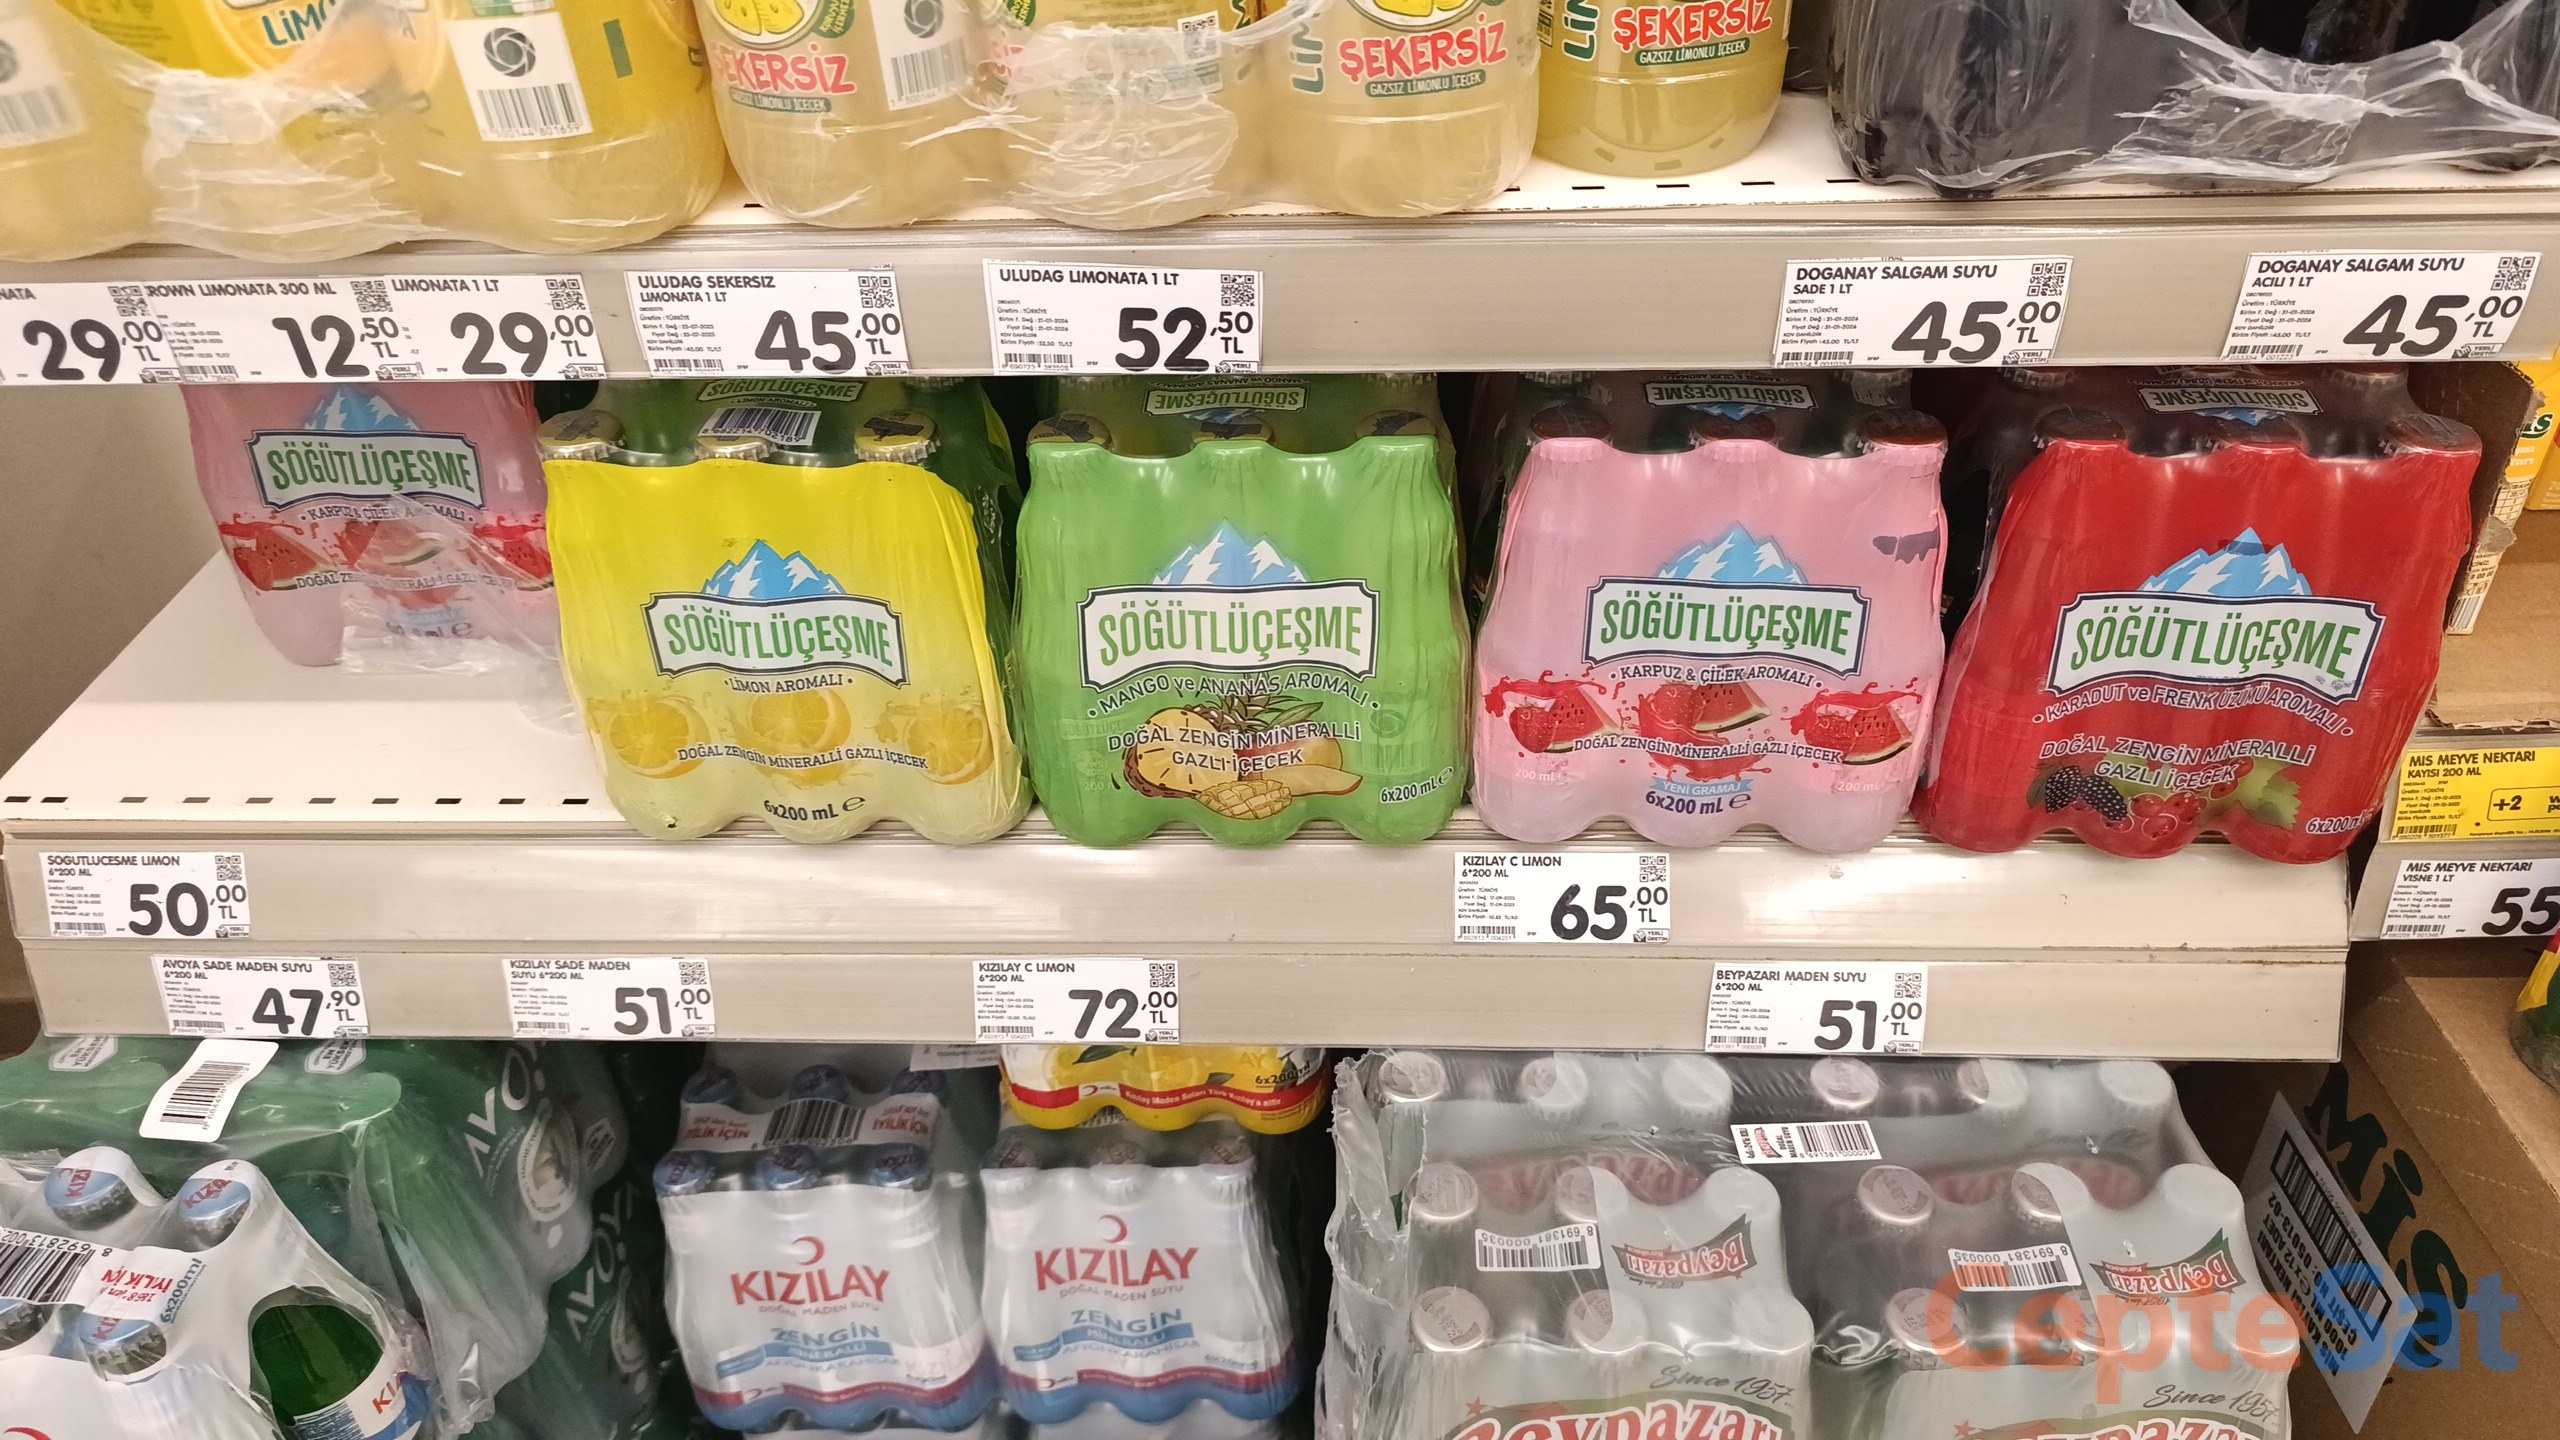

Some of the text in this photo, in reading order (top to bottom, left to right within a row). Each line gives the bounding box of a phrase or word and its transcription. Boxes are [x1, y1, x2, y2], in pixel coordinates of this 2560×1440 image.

[1613, 0, 1772, 51] ŞEKERSİZ
[1339, 13, 1506, 83] ŞEKERSİZ
[1639, 39, 1747, 64] GAZSIZ LİMONLU İÇECEK
[1369, 71, 1482, 96] GAZSIZ LİMONLU İÇECEK
[1000, 269, 1180, 287] ULUDAG LIMONATA LT
[1795, 264, 1998, 281] DOGANAY SALGAM SUYU
[2257, 257, 2465, 274] DOGANAY SALGAM SUYU
[199, 282, 338, 297] LIMONATA 300 ML
[391, 279, 500, 292] LIMONATA LT
[637, 275, 776, 289] ULUDAG SEKERSIZ
[1793, 284, 1854, 295] SADE LT
[2251, 276, 2314, 288] ACILI LT
[640, 292, 728, 303] LIMONATA LT
[266, 440, 475, 493] SÖĞÜTLÜÇEŞME
[1099, 598, 1363, 668] SÖĞÜTLÜÇEŞME
[1600, 590, 1853, 656] SÖĞÜTLÜÇEŞME
[664, 604, 894, 668] SÖĞÜTLÜÇEŞME
[2070, 605, 2361, 680] SÖĞÜTLÜÇEŞME
[729, 673, 843, 694] LİMON AROMALI
[1620, 663, 1813, 689] KARPUZ & ÇİLEK AROMALI
[1098, 672, 1370, 715] MANGO ve ANANAS AROMALI
[2045, 682, 2347, 735] KARADUT ve FRENK ÜZÜMÜ AROMALI
[1108, 719, 1362, 753] DOĞAL ZENGİN MİNERALLİ
[678, 742, 930, 770] DOĞAL ZENGİN MİNERALLİ GAZLI İÇECEK
[1171, 747, 1305, 773] GAZLI İÇECEK
[1573, 734, 1844, 764] DOĞAL ZENGİN MİNERALLİ GAZLI İÇECEK
[2039, 732, 2318, 767] DOĞAL ZENGİN MİNERALLİ
[2408, 750, 2536, 768] MIS MEYVE NEKTARI
[2094, 761, 2240, 793] GAZLI İÇECEK
[2407, 767, 2482, 779] KAYISI 200 ML
[1379, 777, 1440, 804] 6x200 mL
[1662, 779, 1743, 797] YENİ GRAMAJ
[764, 799, 839, 822] 6x200 mL
[1645, 790, 1724, 815] 6x200 mL
[2493, 795, 2523, 811] +2
[47, 855, 181, 867] SOGUTLUCESME LIMON
[1462, 855, 1562, 867] KIZILAY C LIMON
[1494, 869, 1509, 878] ML
[2406, 861, 2534, 873] MIS MEYVE NEKTARI
[2402, 874, 2456, 883] VISNE LT
[162, 958, 313, 973] AVOYA SADE MADEN SUYU
[510, 959, 631, 971] KIZILAY SADE MADEN
[511, 970, 537, 980] SUYU
[978, 962, 1076, 973] KIZILAY C LIMON
[1716, 970, 1867, 983] BEYPAZARI MADEN SUYU
[1747, 983, 1763, 992] ML
[2265, 1189, 2314, 1269] 05013-02
[1625, 1232, 1748, 1278] Beypazarı
[1953, 1246, 2055, 1263] 691381 000035
[1034, 1247, 1199, 1292] KIZILAY
[2108, 1250, 2238, 1295] Beypazarı
[730, 1264, 891, 1305] KIZILAY
[1070, 1307, 1183, 1334] ZENGİN
[770, 1321, 881, 1347] ZENGİN
[1649, 1365, 1731, 1390] Since
[2143, 1384, 2226, 1410] Since
